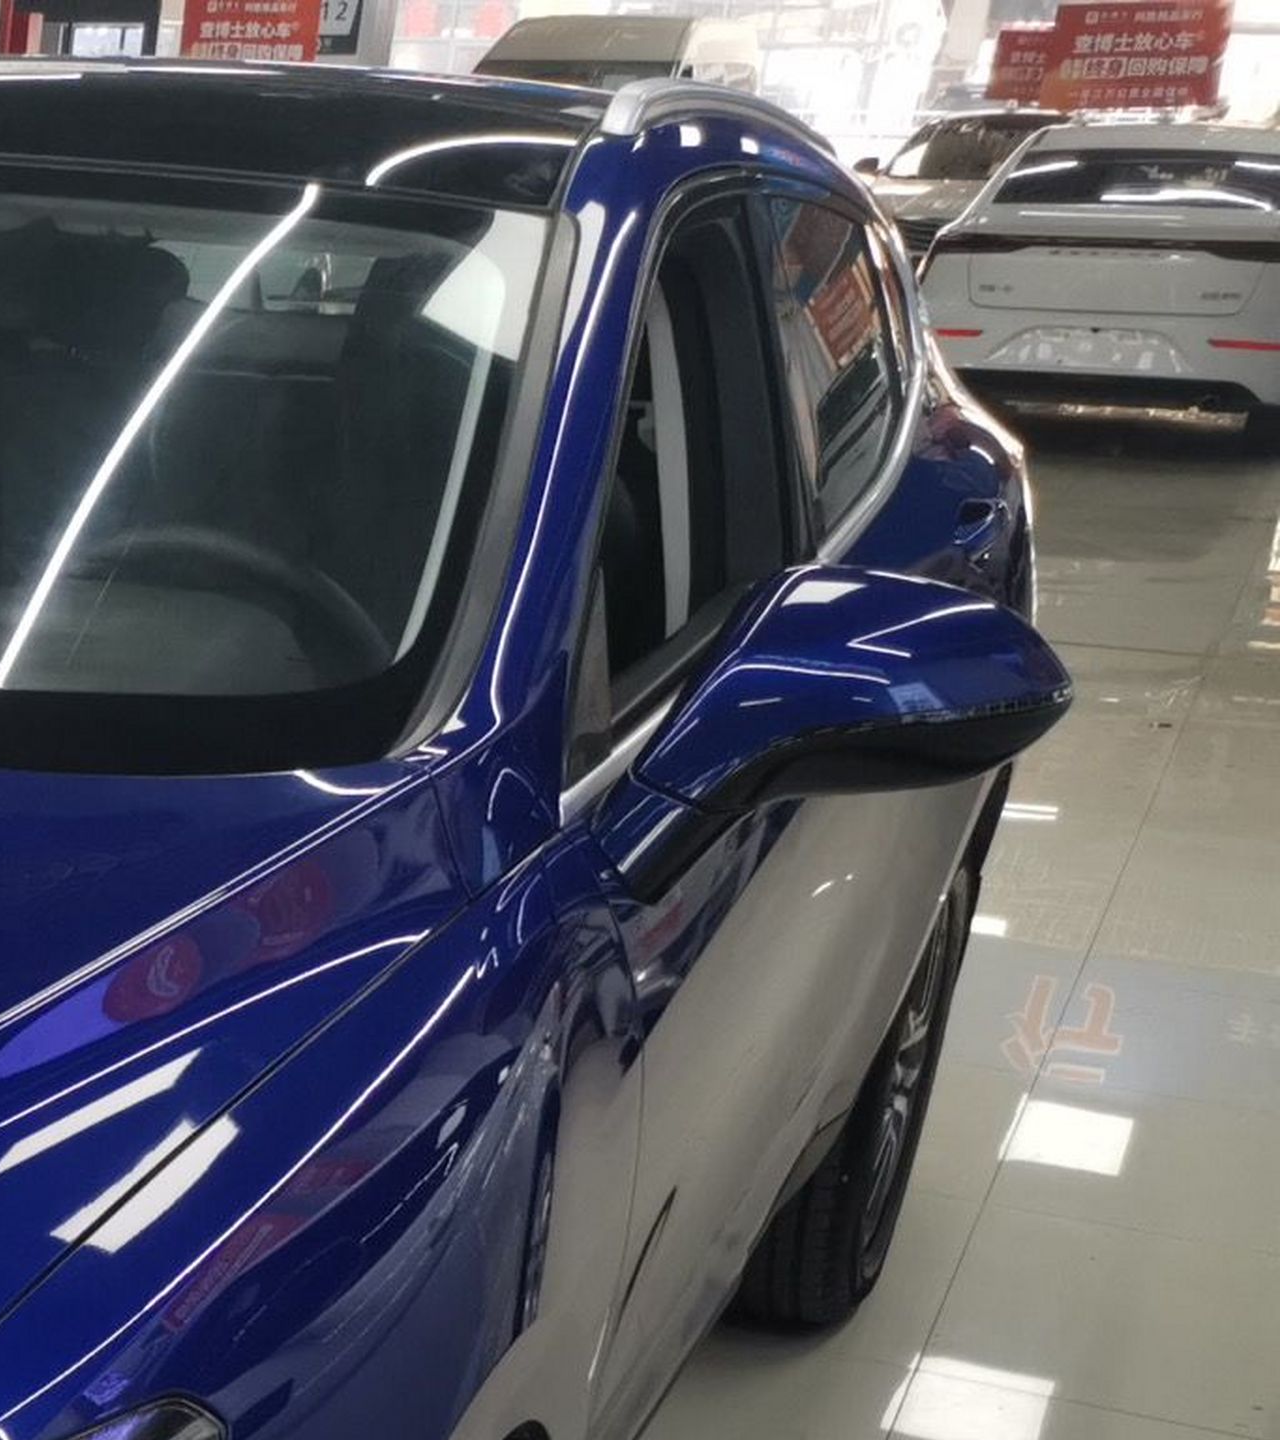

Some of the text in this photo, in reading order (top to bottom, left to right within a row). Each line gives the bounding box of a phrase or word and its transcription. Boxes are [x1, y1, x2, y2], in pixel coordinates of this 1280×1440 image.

[200, 22, 292, 39] 查博士放心车
[1073, 33, 1195, 54] 查博士放心车
